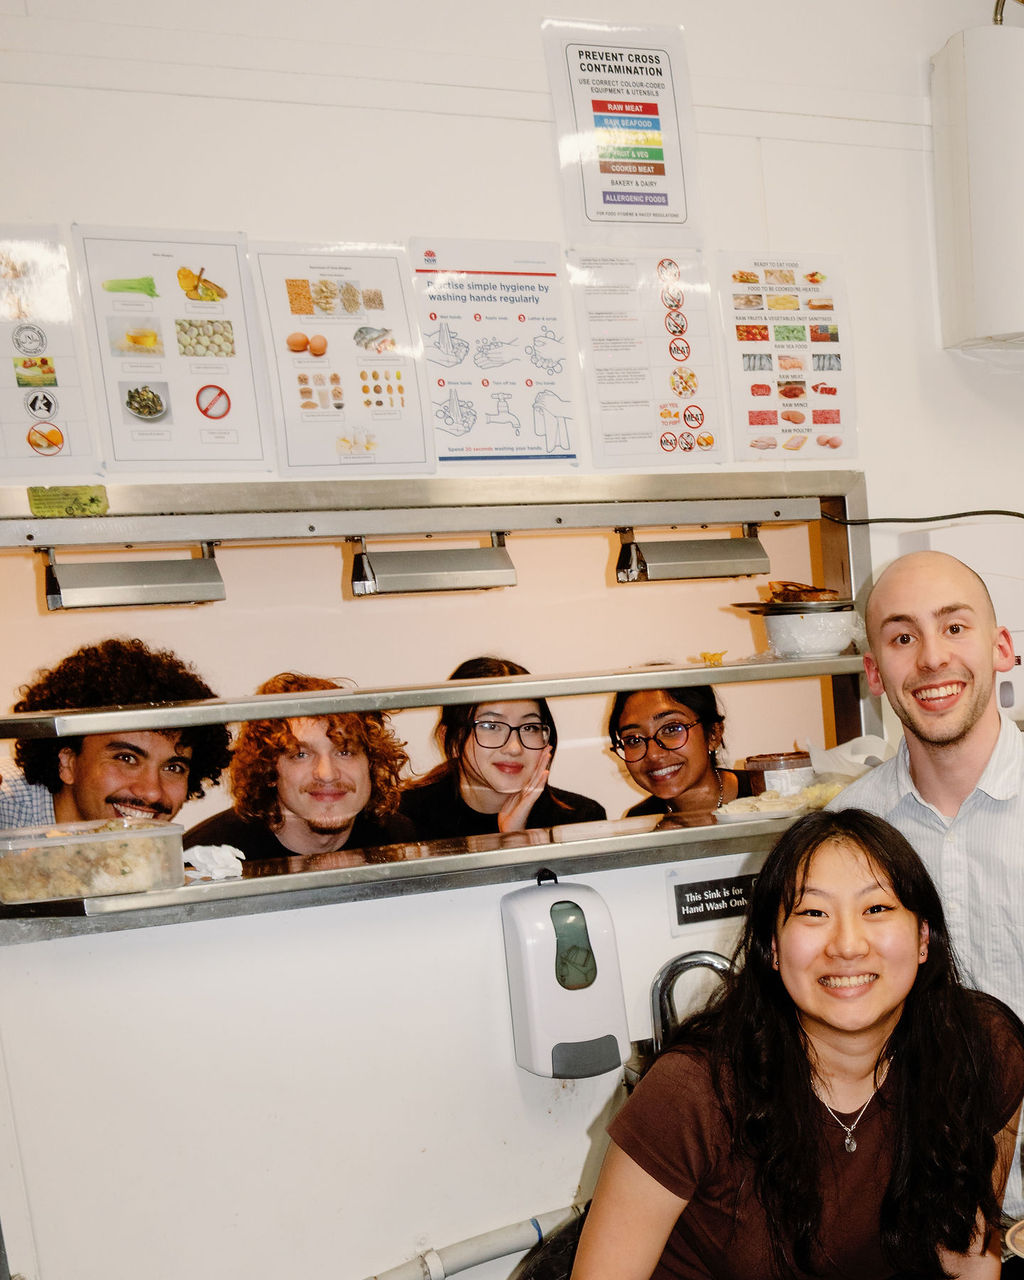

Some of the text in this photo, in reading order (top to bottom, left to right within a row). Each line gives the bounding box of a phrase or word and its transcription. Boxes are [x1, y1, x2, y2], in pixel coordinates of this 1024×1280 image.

[578, 50, 661, 64] PREVENT CROSS
[579, 63, 663, 76] CONTAMINATION
[621, 81, 665, 89] COLOUR-CODED
[607, 103, 643, 112] RAW MEAT
[603, 118, 652, 127] RAW SEAFOOD
[611, 164, 637, 172] COOKED
[605, 194, 644, 203] ALLERGENIC
[467, 281, 497, 292] simple
[499, 282, 536, 293] hygiene
[538, 283, 549, 293] by
[428, 293, 540, 304] washing hands regularly
[685, 886, 744, 903] This Sink is for
[681, 903, 704, 915] Hand
[705, 900, 728, 912] Wash
